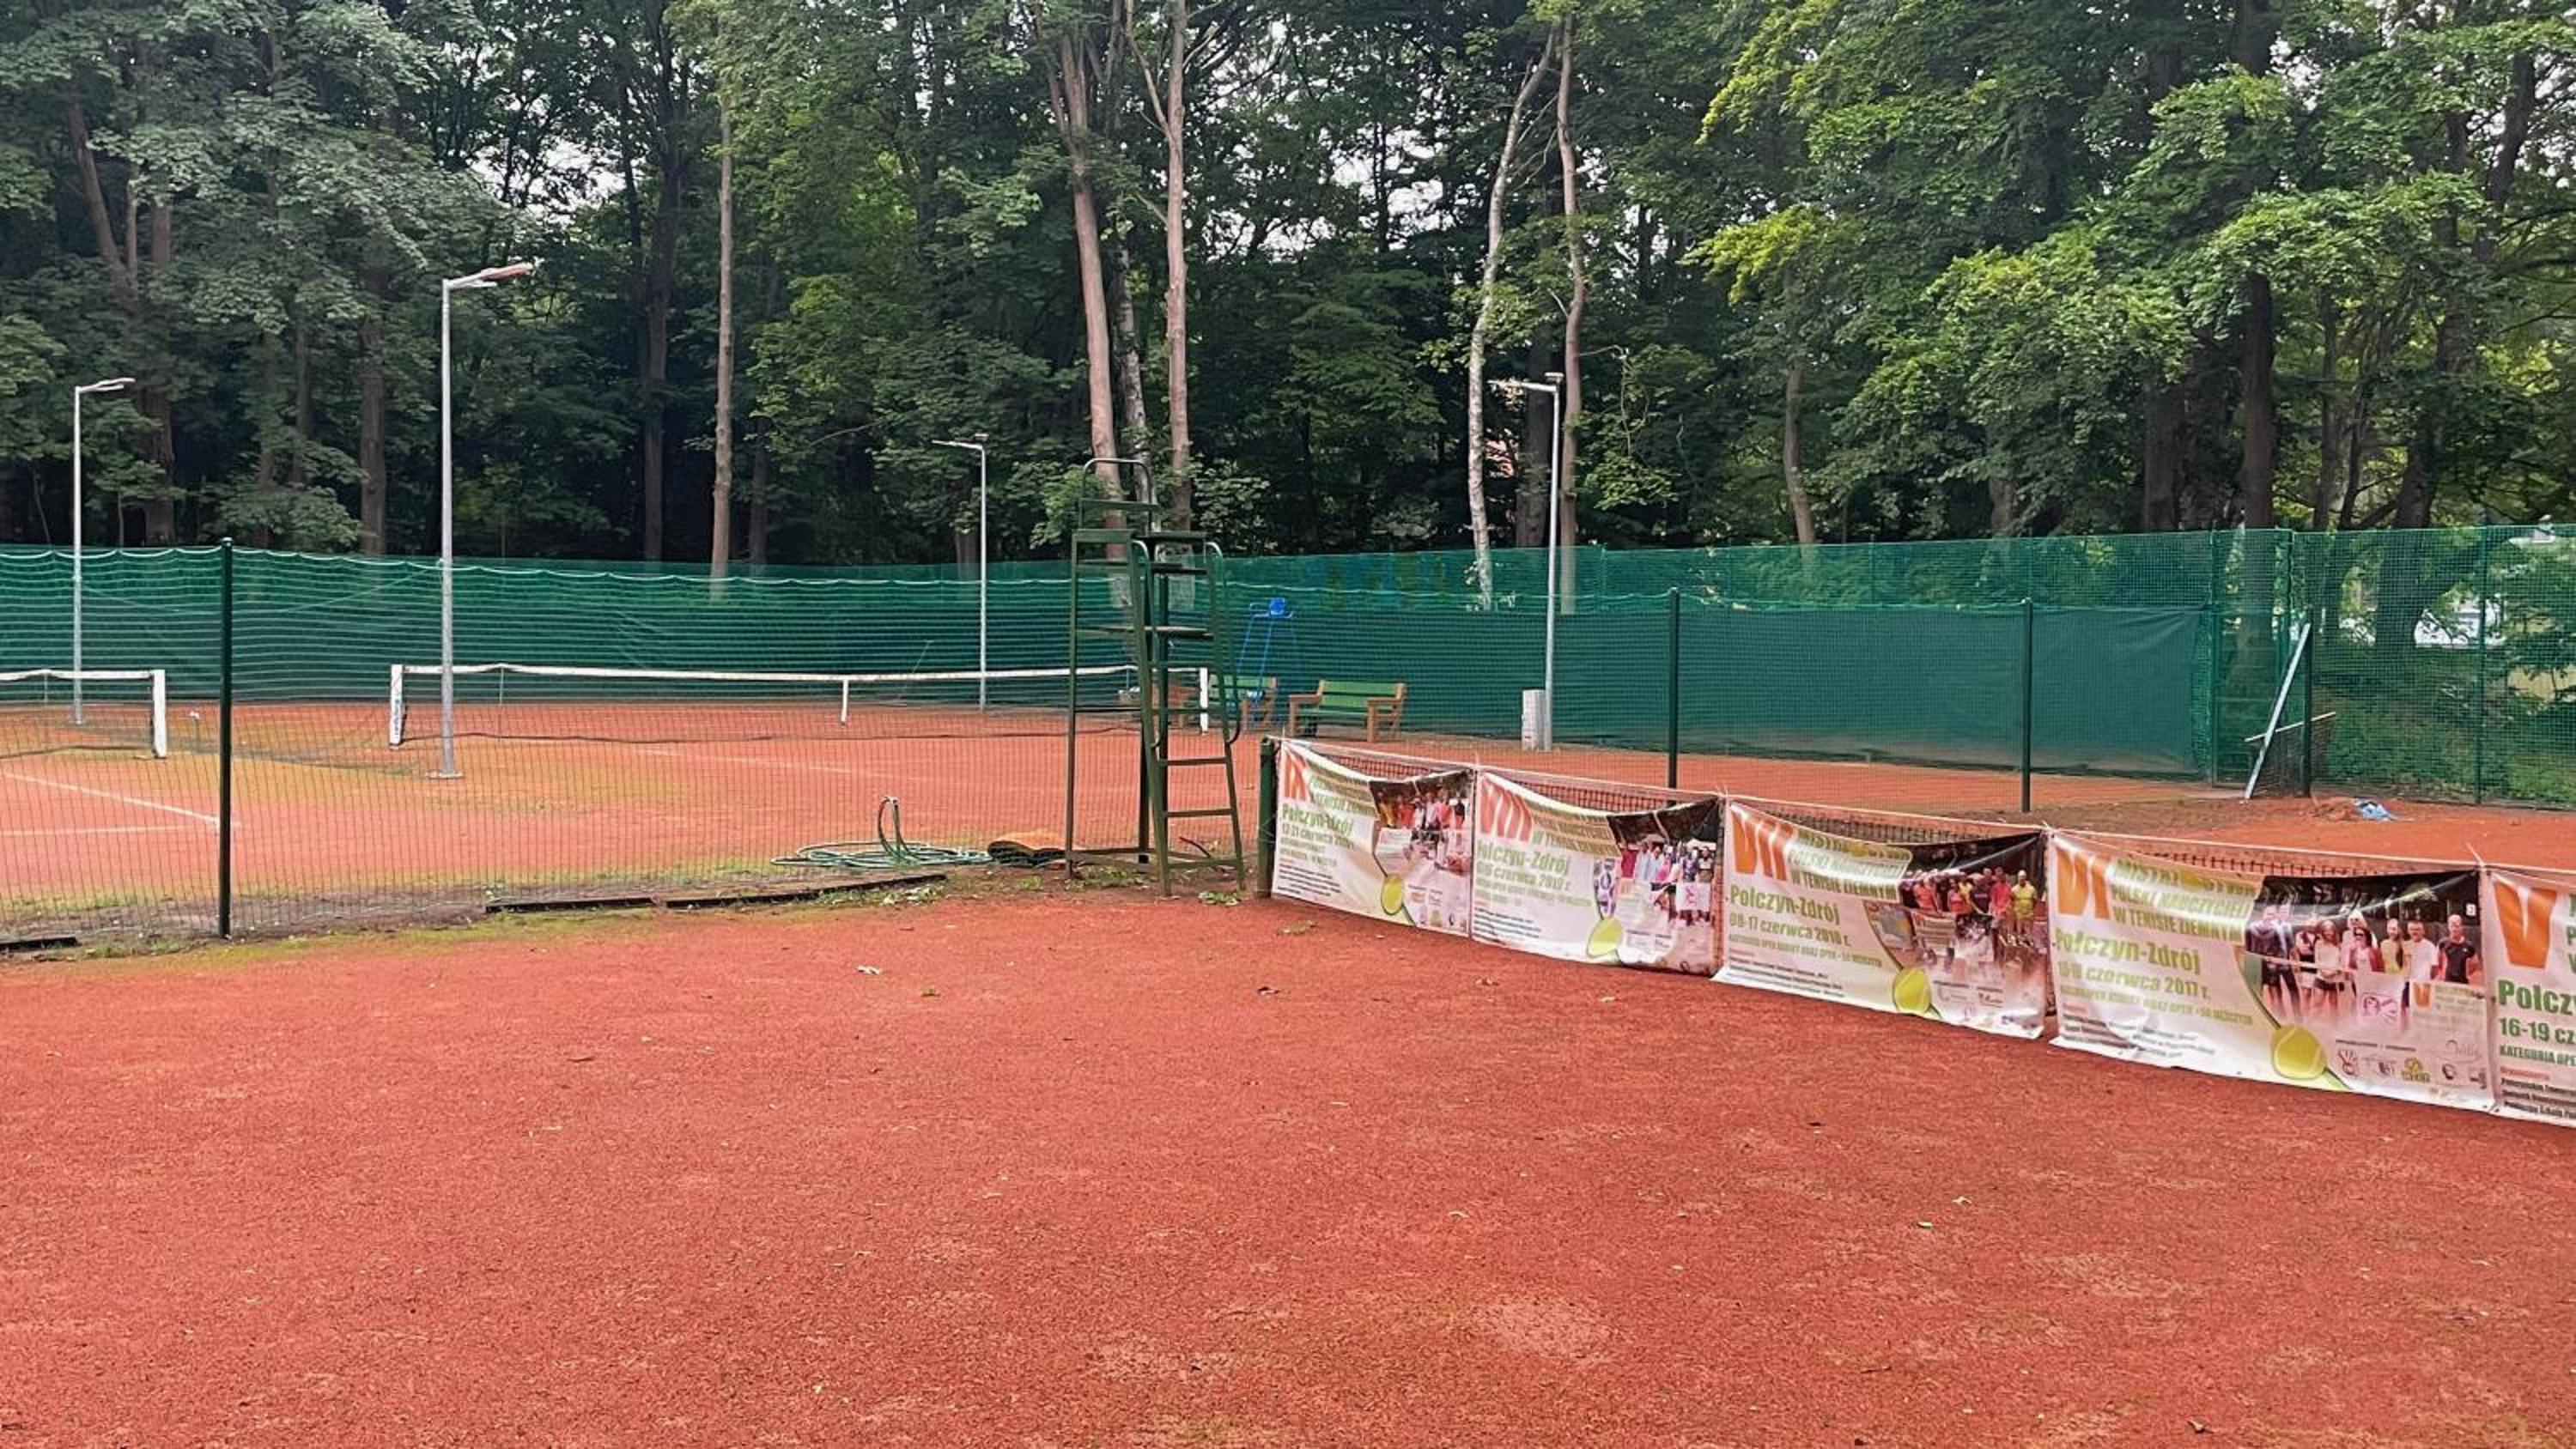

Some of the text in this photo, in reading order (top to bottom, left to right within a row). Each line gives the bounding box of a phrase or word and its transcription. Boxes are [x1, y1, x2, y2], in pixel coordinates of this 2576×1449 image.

[1760, 919, 1814, 940] czerwca
[2494, 879, 2557, 968] V
[2086, 967, 2160, 991] czerwca
[2164, 976, 2197, 998] 2017
[2499, 979, 2576, 1017] Połcz
[2500, 1017, 2550, 1043] 16-19
